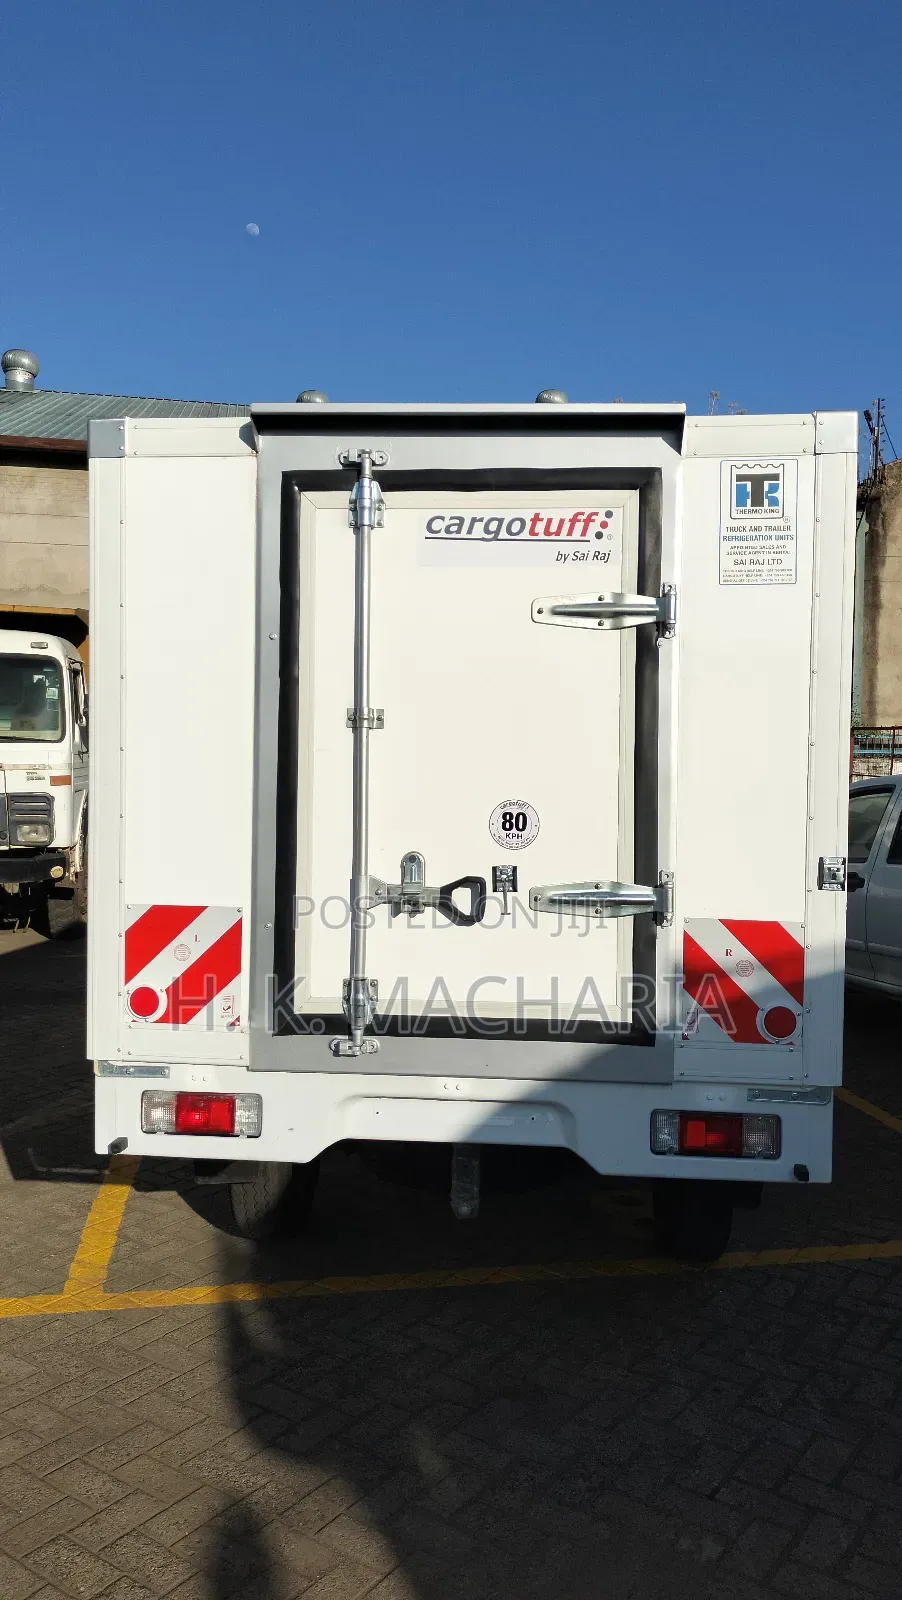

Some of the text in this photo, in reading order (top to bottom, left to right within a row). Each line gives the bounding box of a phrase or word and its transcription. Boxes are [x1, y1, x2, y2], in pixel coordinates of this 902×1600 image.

[425, 511, 600, 542] cargotuff
[726, 525, 747, 533] TRUCK
[722, 534, 773, 542] REFRIGERATION
[555, 549, 612, 564] by Sai Raj
[733, 558, 783, 566] SAI RAJ LTD
[501, 811, 528, 832] 80
[505, 832, 523, 840] KPH
[725, 949, 733, 957] R
